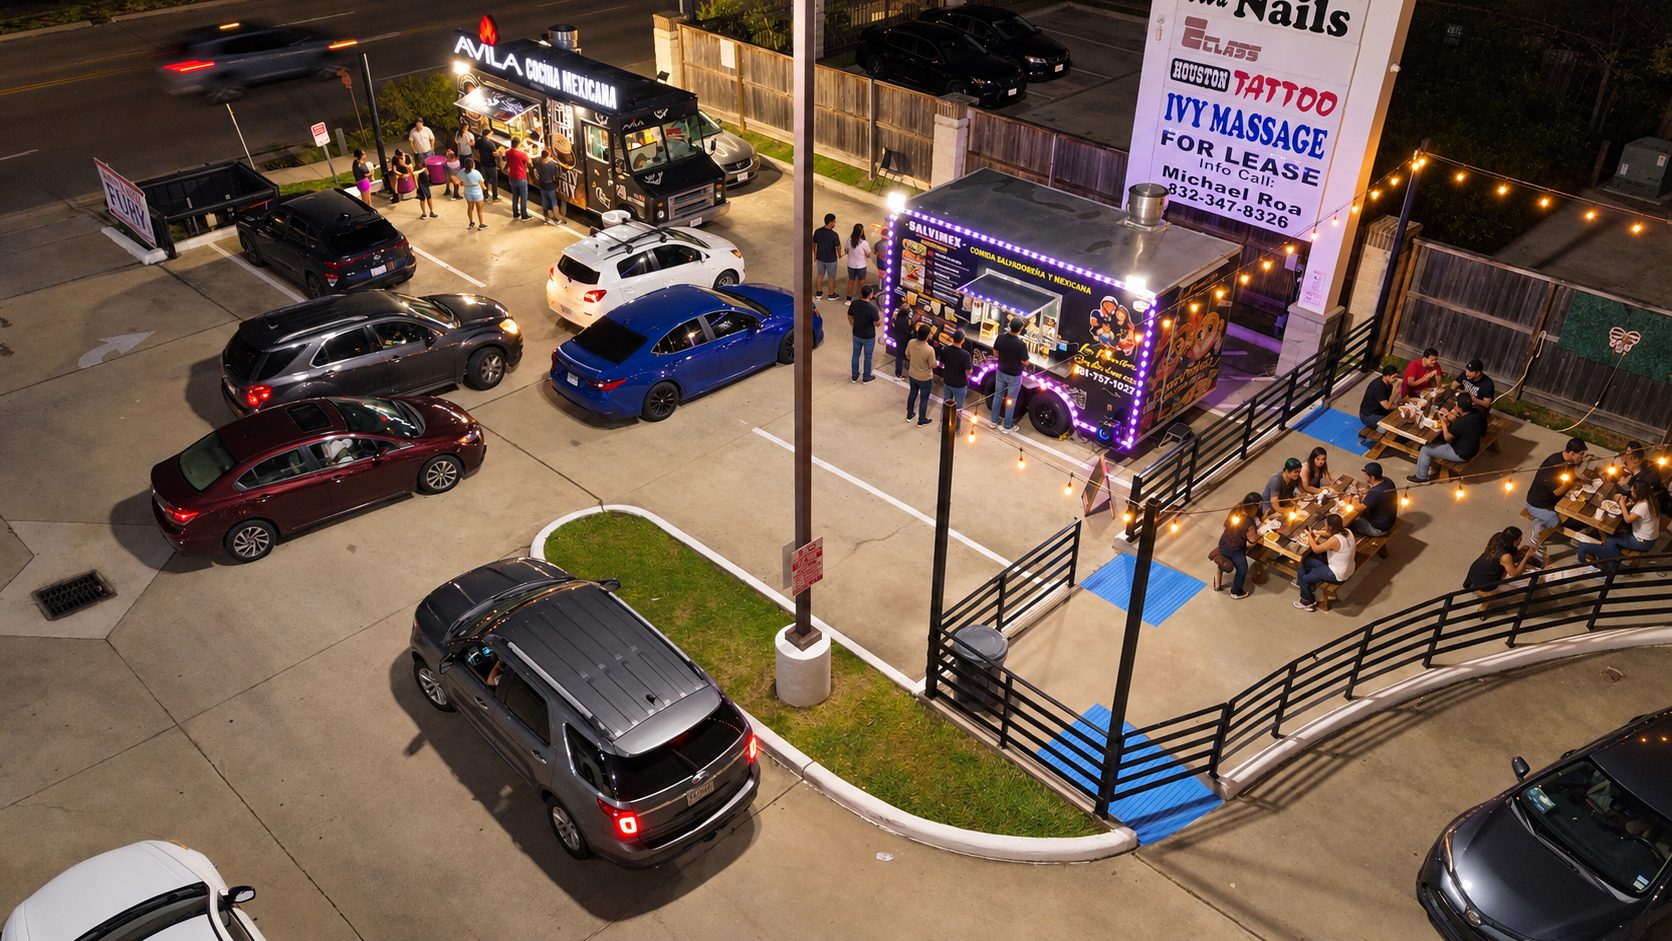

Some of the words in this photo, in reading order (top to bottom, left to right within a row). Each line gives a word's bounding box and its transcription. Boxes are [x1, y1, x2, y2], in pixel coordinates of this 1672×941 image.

[1234, 0, 1350, 37] Nails
[454, 36, 523, 76] AVILA
[1172, 60, 1229, 90] HOUSTON
[1233, 70, 1338, 117] TATTOO
[1164, 92, 1209, 128] IVY
[1209, 103, 1328, 159] MASSAGE
[1160, 129, 1214, 158] FOR
[1224, 146, 1321, 187] LEASE
[1199, 158, 1232, 177] Info
[1238, 168, 1275, 188] Call:
[1162, 165, 1249, 201] Michael
[1257, 192, 1302, 217] Roa
[1167, 183, 1289, 229] 832-347-8326
[1048, 273, 1054, 281] Y
[1074, 364, 1136, 395] 81-757-1027
